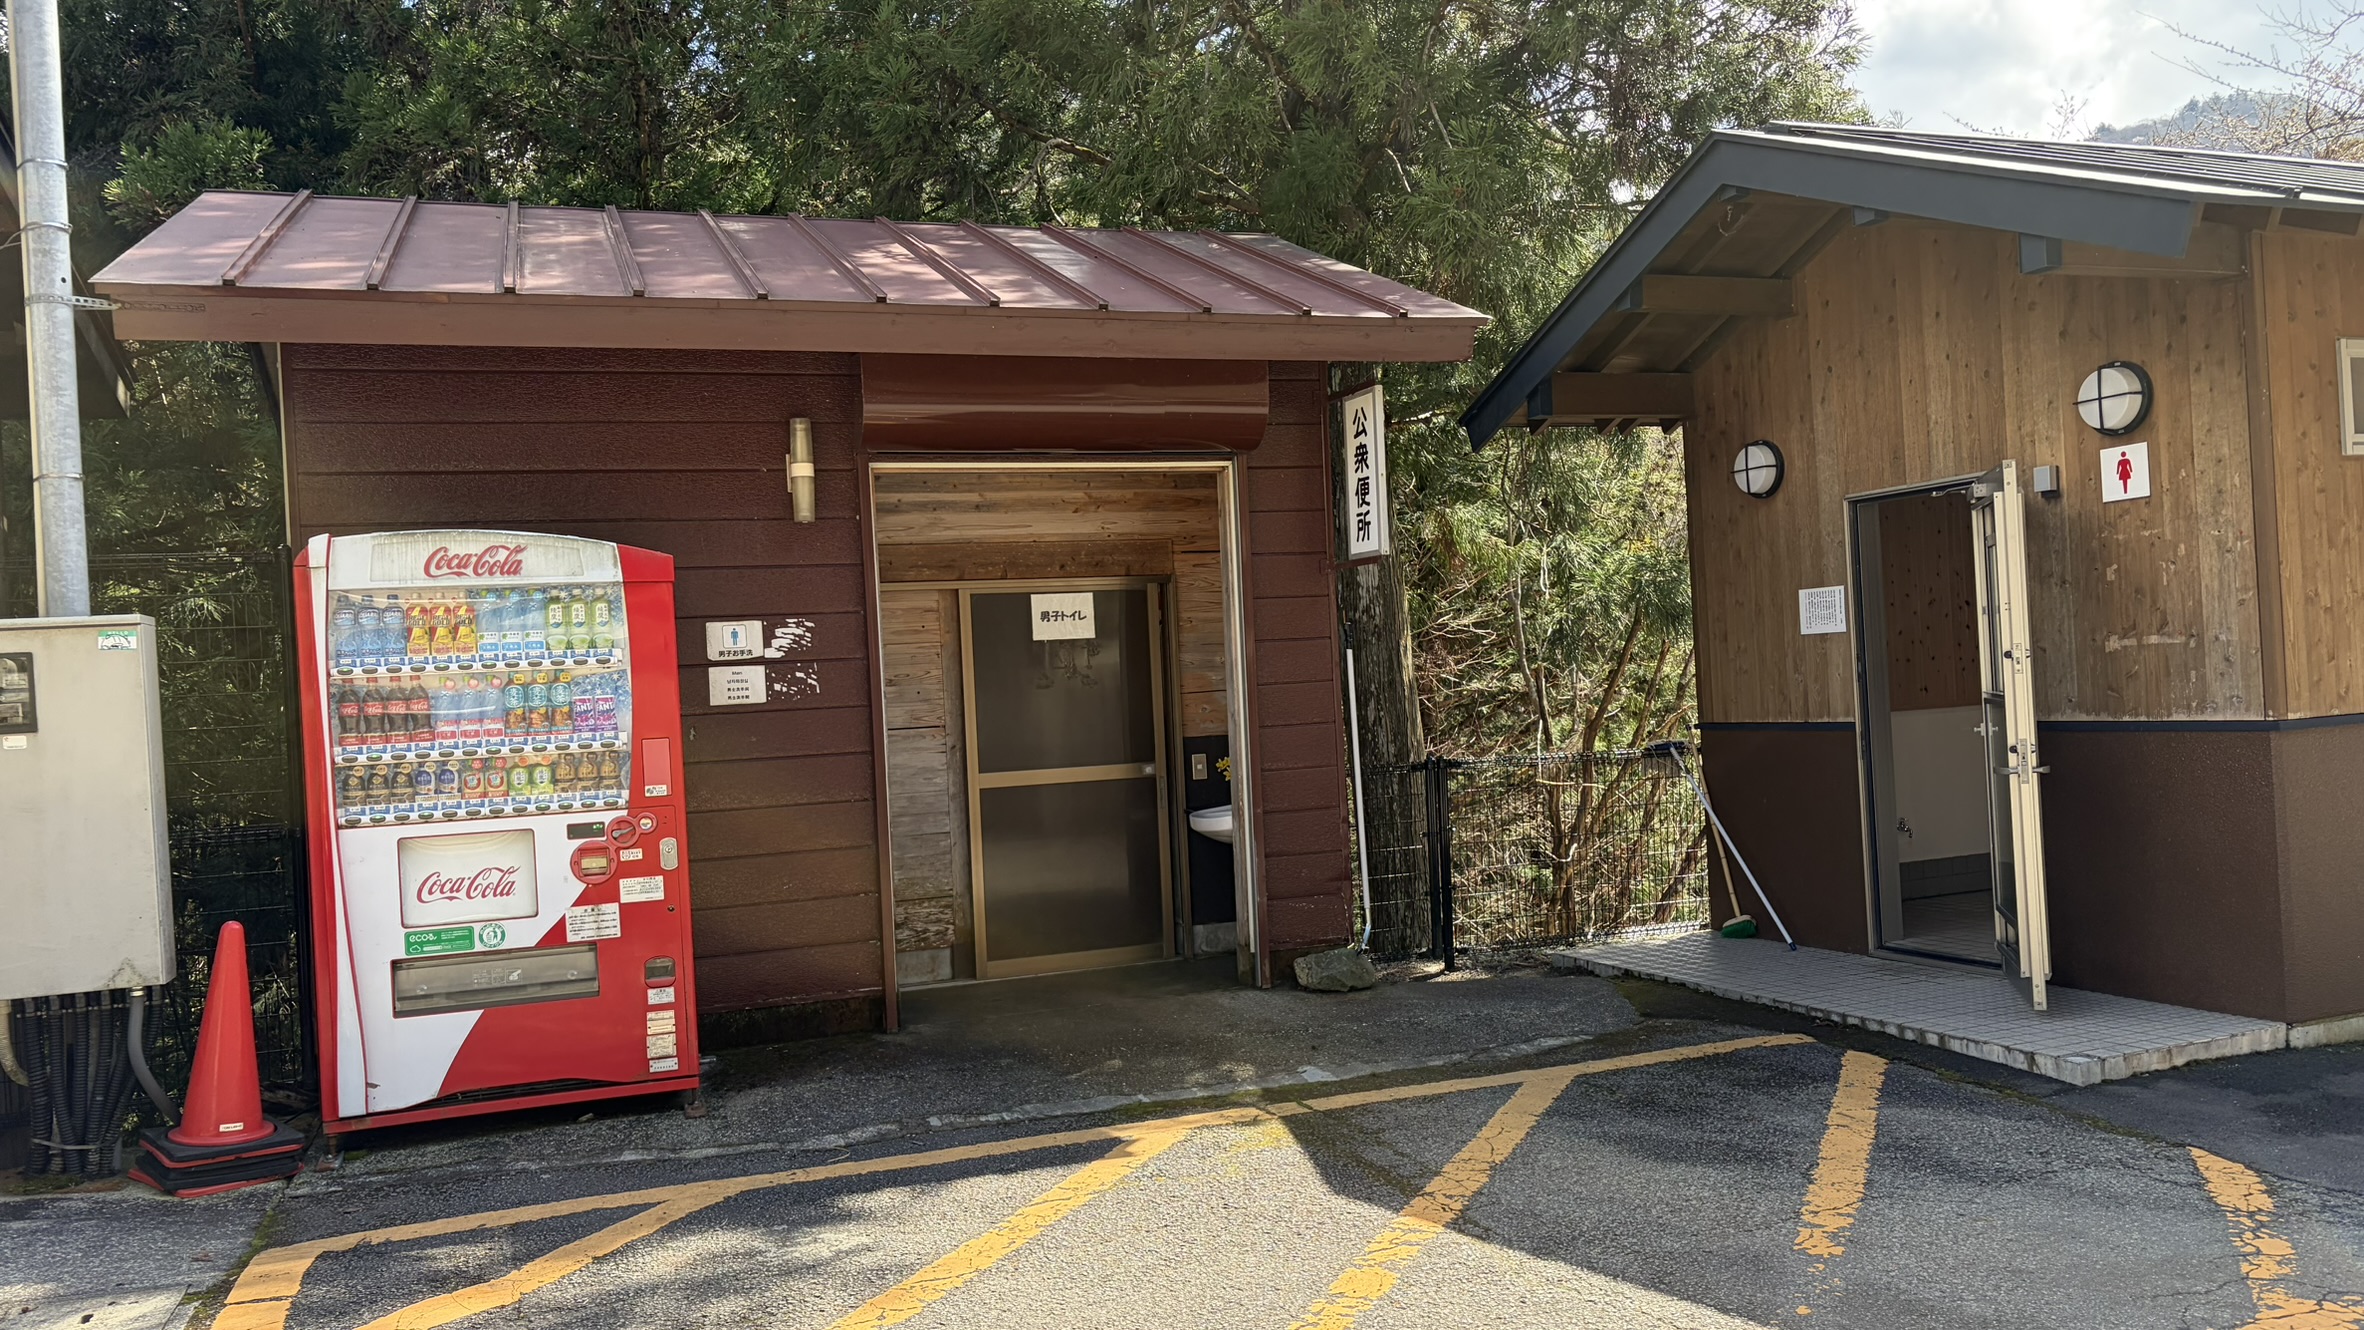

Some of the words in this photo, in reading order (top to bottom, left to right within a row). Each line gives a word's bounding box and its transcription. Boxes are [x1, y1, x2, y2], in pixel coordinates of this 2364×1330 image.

[1352, 406, 1372, 543] 公衆便所
[424, 544, 528, 579] Coca-Cola
[1040, 610, 1087, 623] 男子トイレ
[718, 649, 754, 658] 男子お手洗
[416, 866, 521, 904] Coca-Cola
